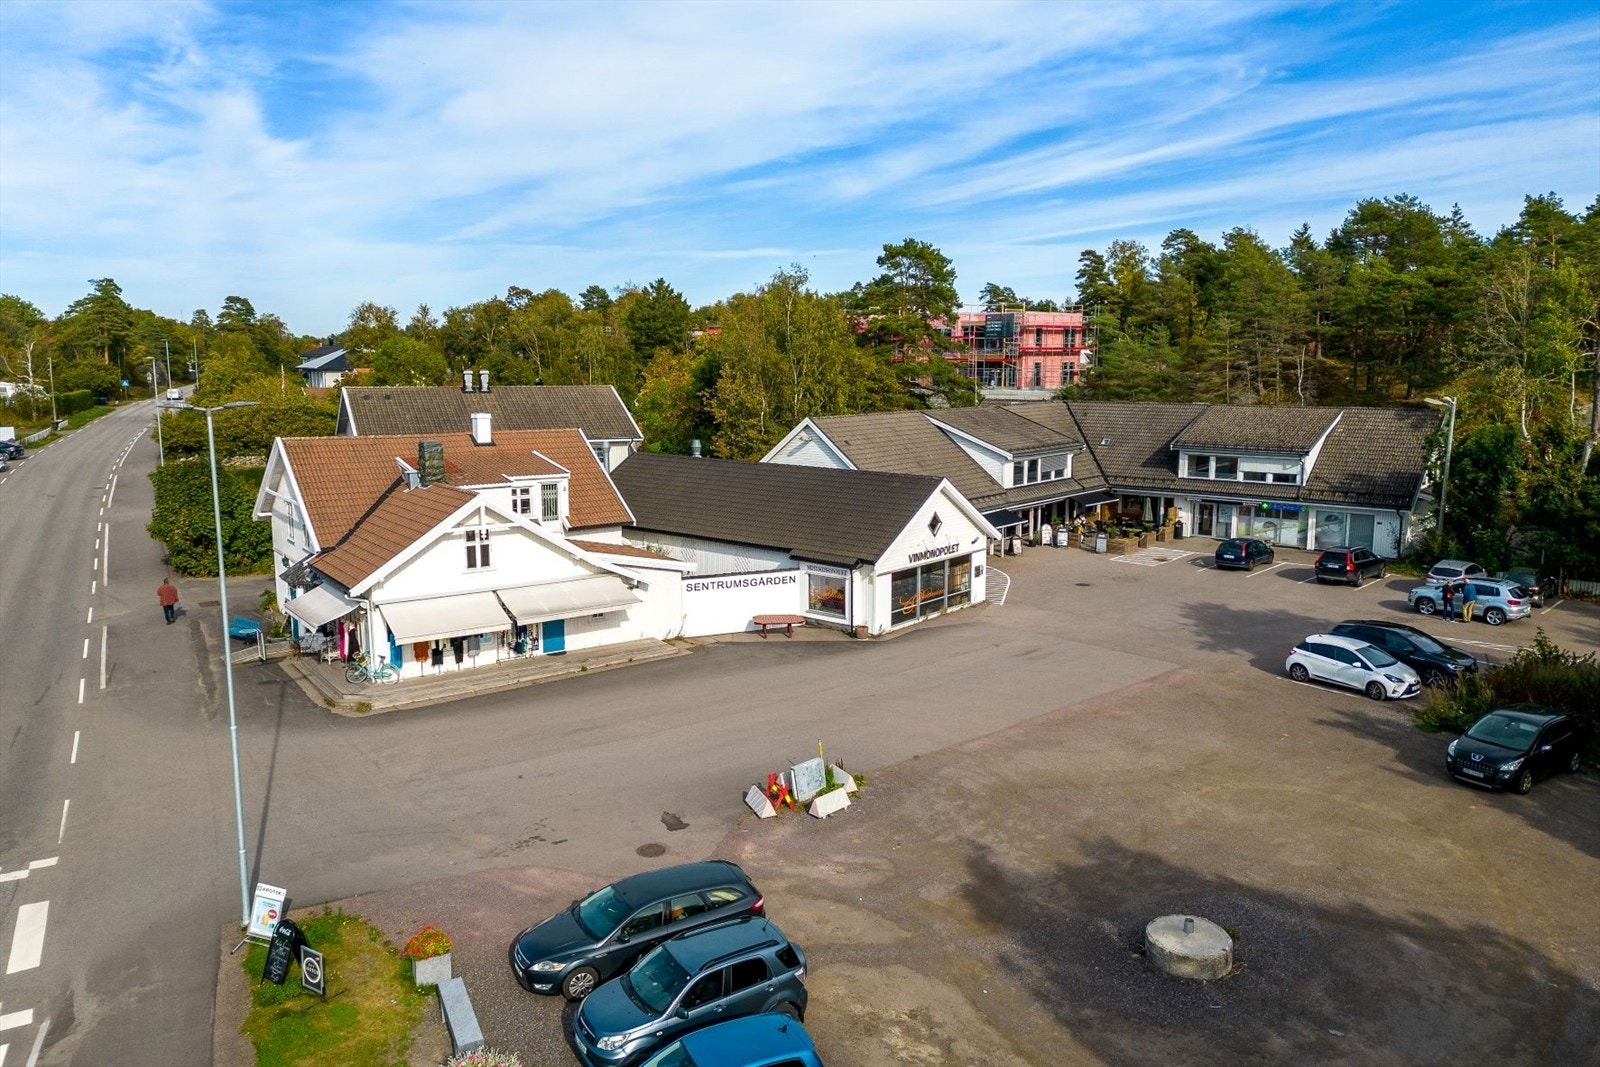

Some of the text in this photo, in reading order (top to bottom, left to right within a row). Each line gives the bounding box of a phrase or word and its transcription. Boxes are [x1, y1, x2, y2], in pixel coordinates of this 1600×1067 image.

[908, 543, 960, 564] VINMONOPOLET
[686, 575, 796, 592] SENTRUMSGÅRDEN
[262, 887, 282, 896] APOTEK
